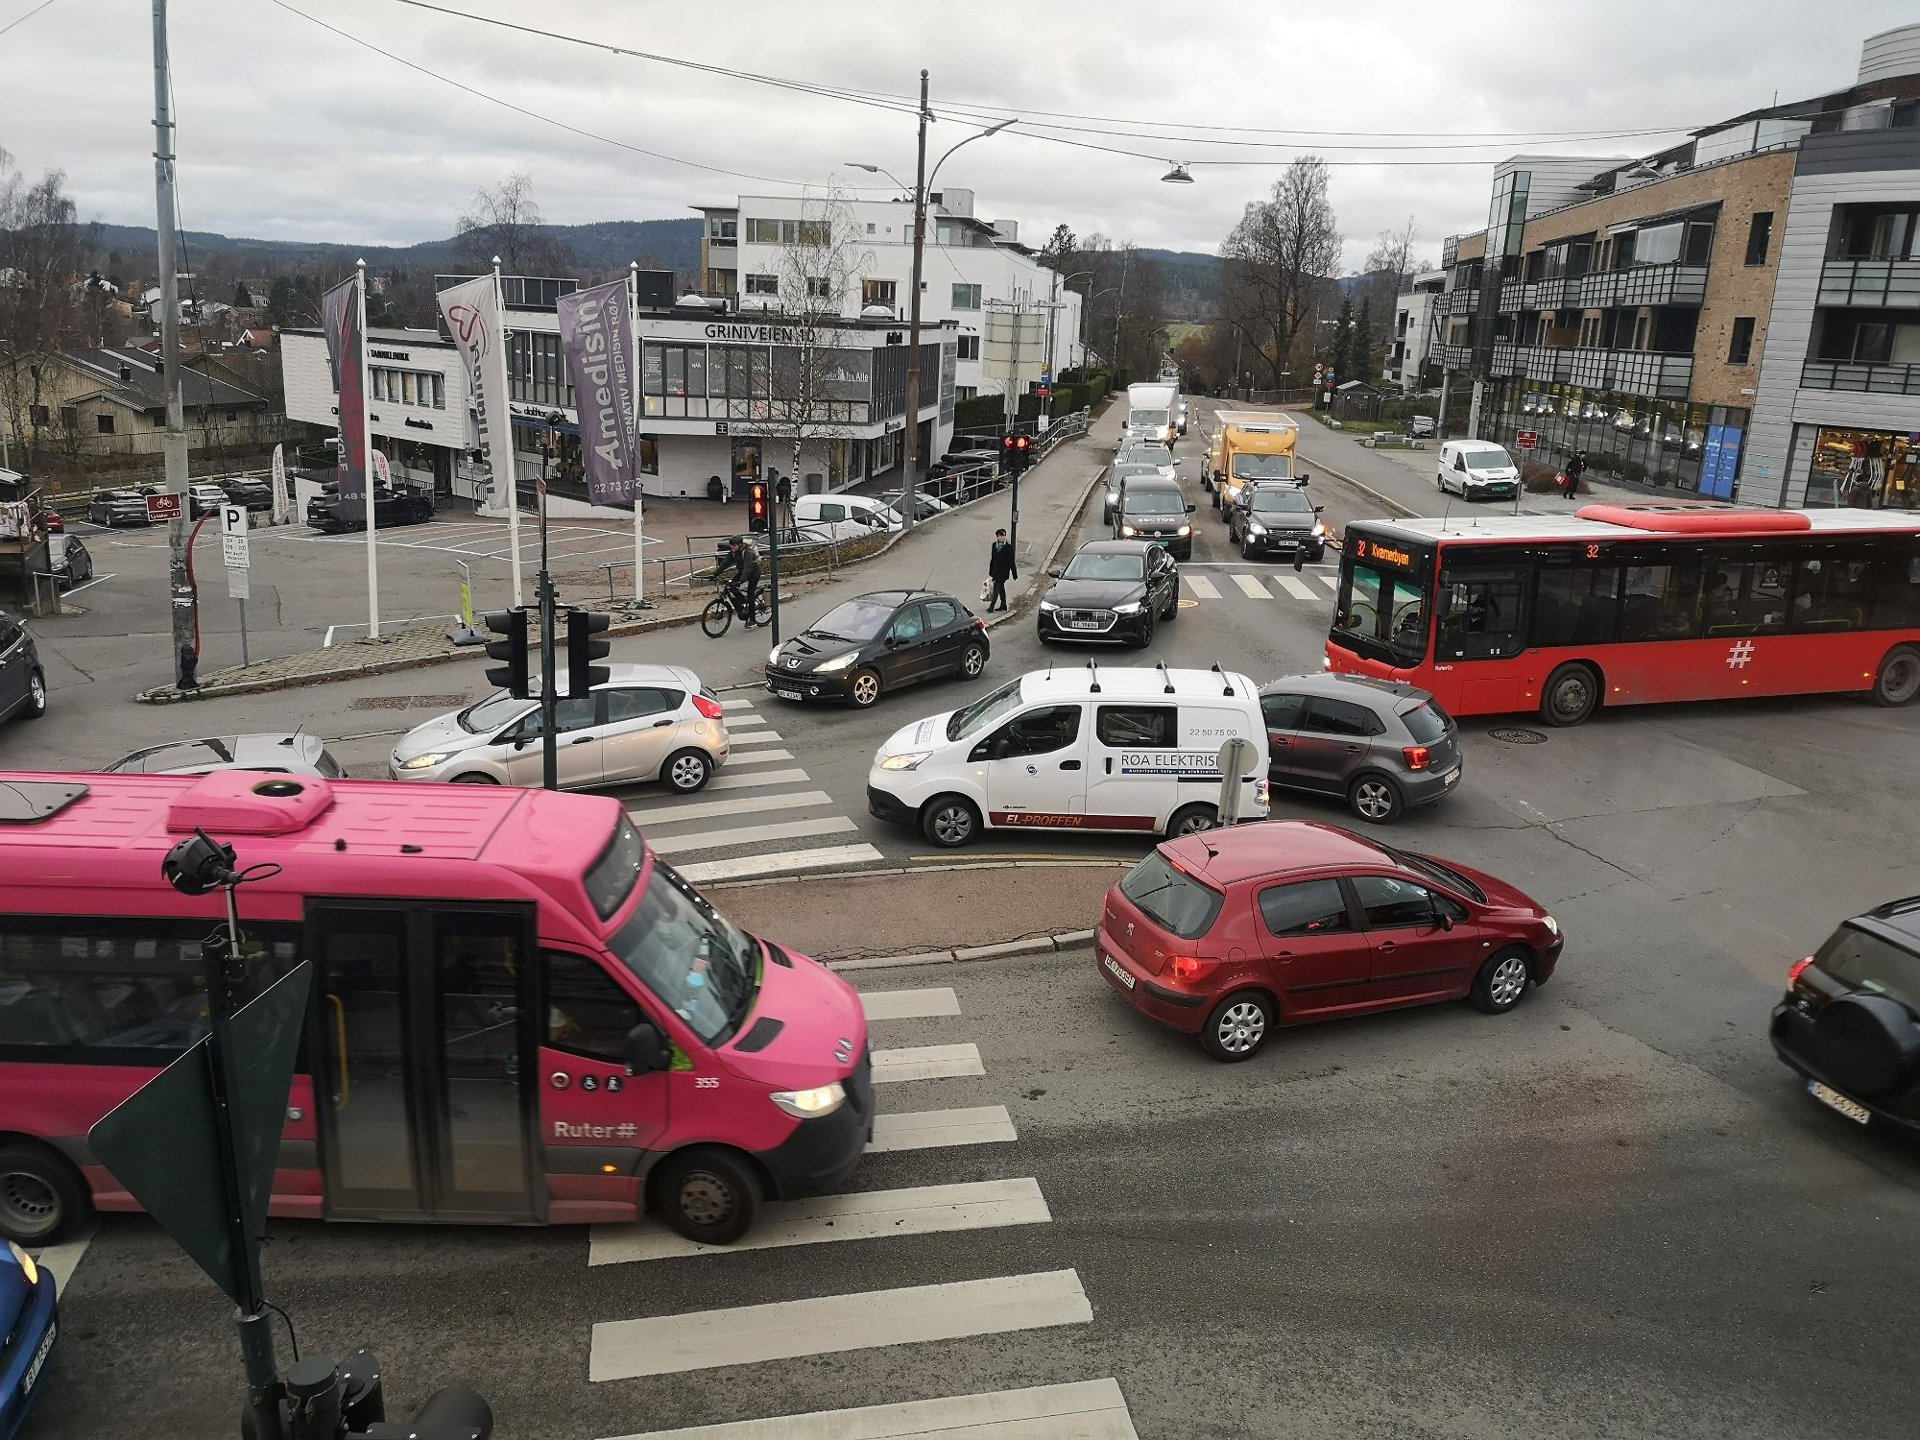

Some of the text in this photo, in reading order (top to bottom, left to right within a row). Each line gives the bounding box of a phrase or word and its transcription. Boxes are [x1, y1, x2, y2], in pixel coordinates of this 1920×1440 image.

[606, 294, 621, 326] RØA
[704, 324, 816, 343] GRINIVEIEN 10
[612, 327, 628, 385] MEDISIN
[575, 299, 623, 470] Amedisin
[609, 481, 622, 492] 73
[226, 509, 240, 532] P
[1357, 540, 1366, 557] 32
[1586, 544, 1599, 558] 32
[1189, 728, 1200, 736] 22
[1121, 754, 1220, 767] RØA ELEKTRIS
[694, 1077, 720, 1089] 355
